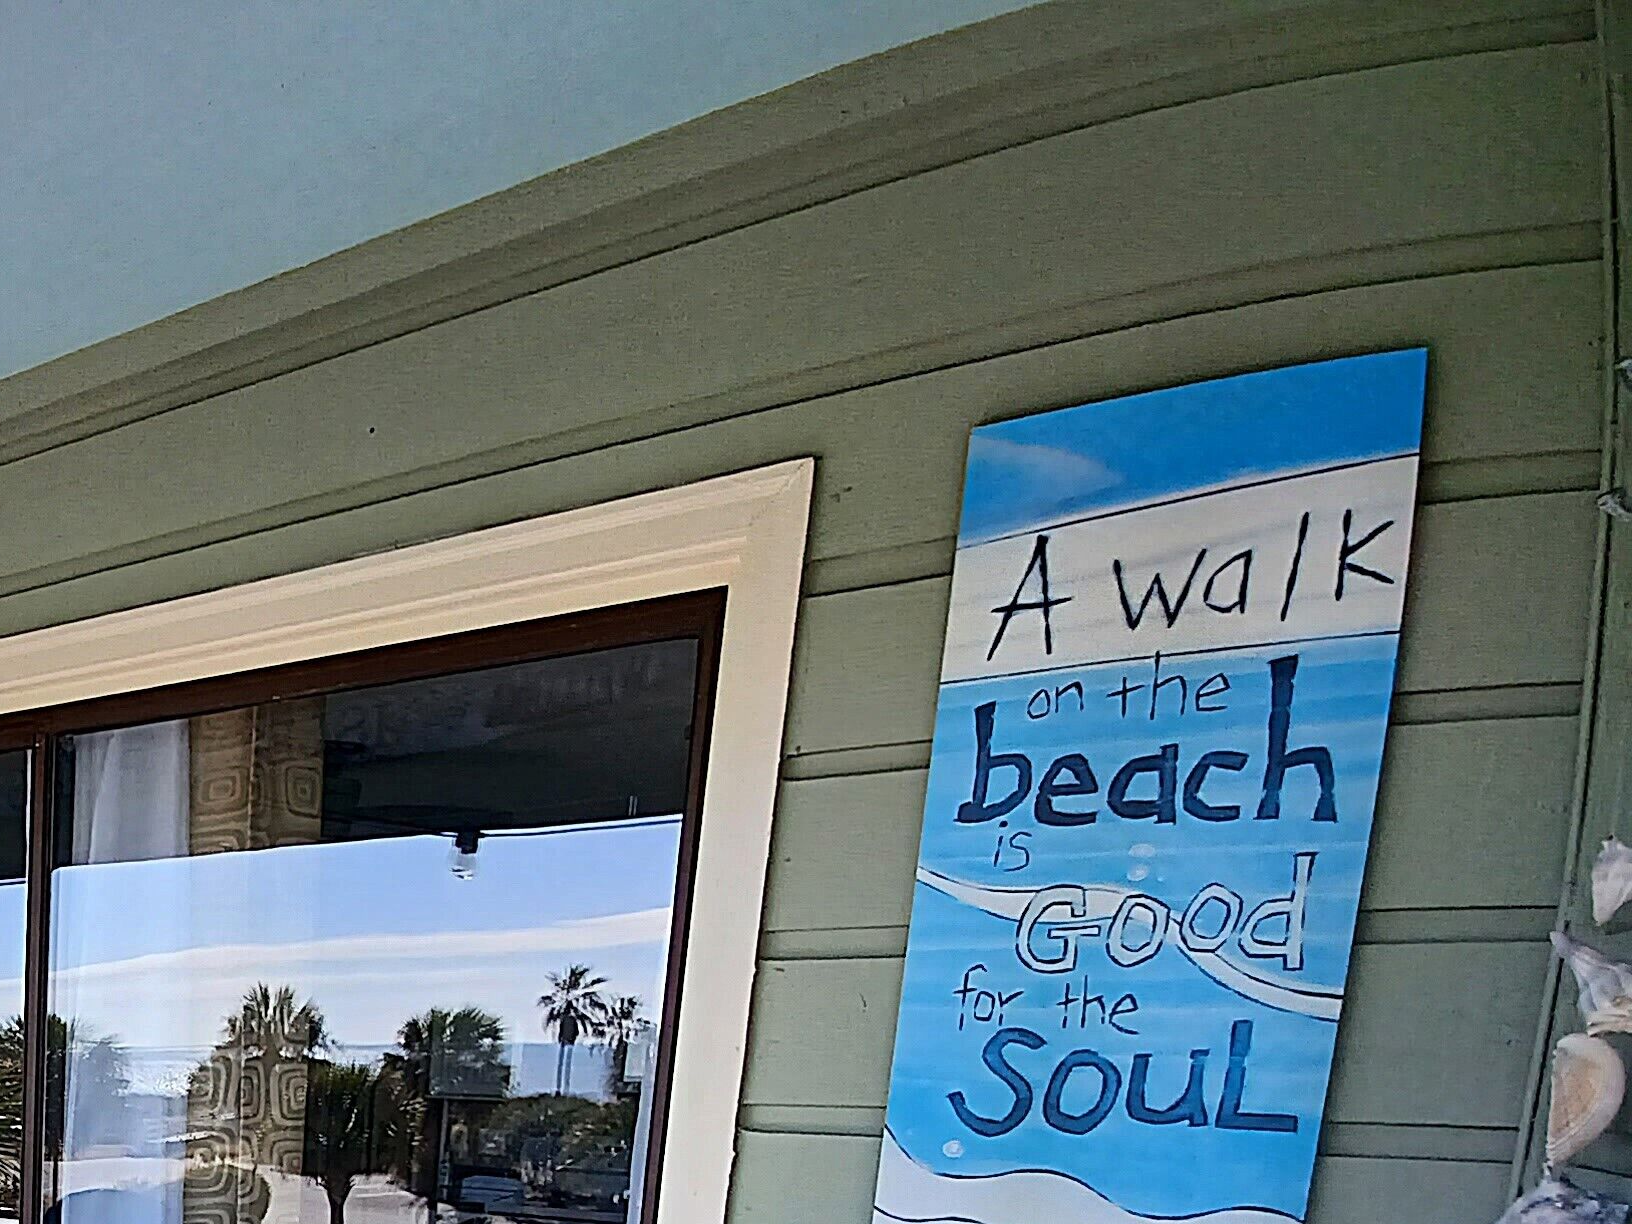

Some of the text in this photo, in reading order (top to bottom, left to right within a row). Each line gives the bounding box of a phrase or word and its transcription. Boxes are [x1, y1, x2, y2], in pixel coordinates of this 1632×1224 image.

[987, 534, 1074, 661] A
[1027, 651, 1231, 720] on the
[953, 654, 1338, 826] beach
[992, 820, 1031, 871] is
[953, 964, 1139, 1036] for the
